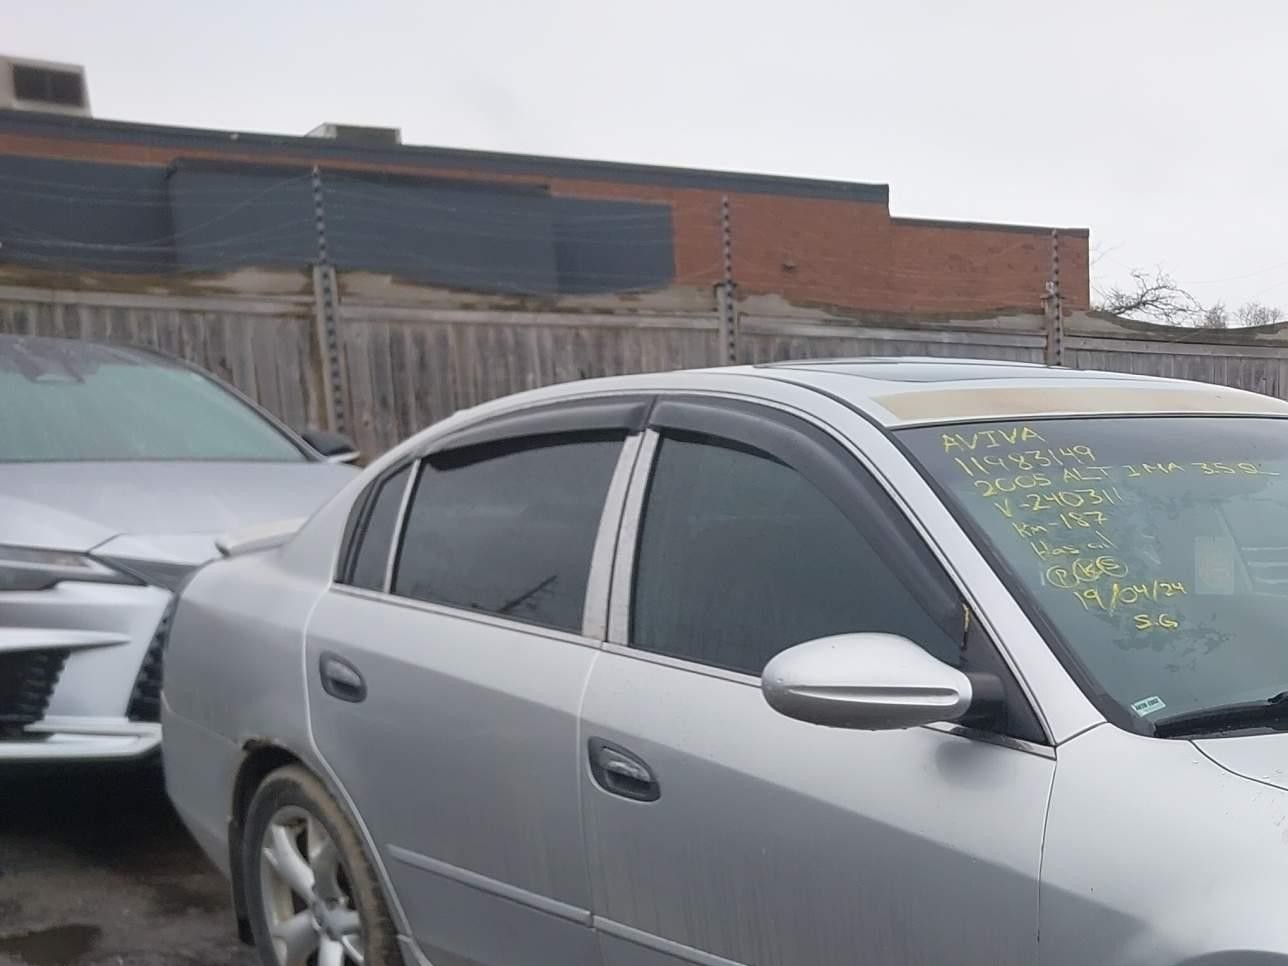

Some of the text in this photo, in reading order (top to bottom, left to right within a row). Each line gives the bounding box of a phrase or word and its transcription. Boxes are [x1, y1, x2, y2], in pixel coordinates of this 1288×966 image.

[942, 427, 1047, 453] AVIVA
[955, 445, 1095, 477] 11983149
[974, 473, 1052, 497] 2005
[1073, 579, 1187, 617] 19/04/24
